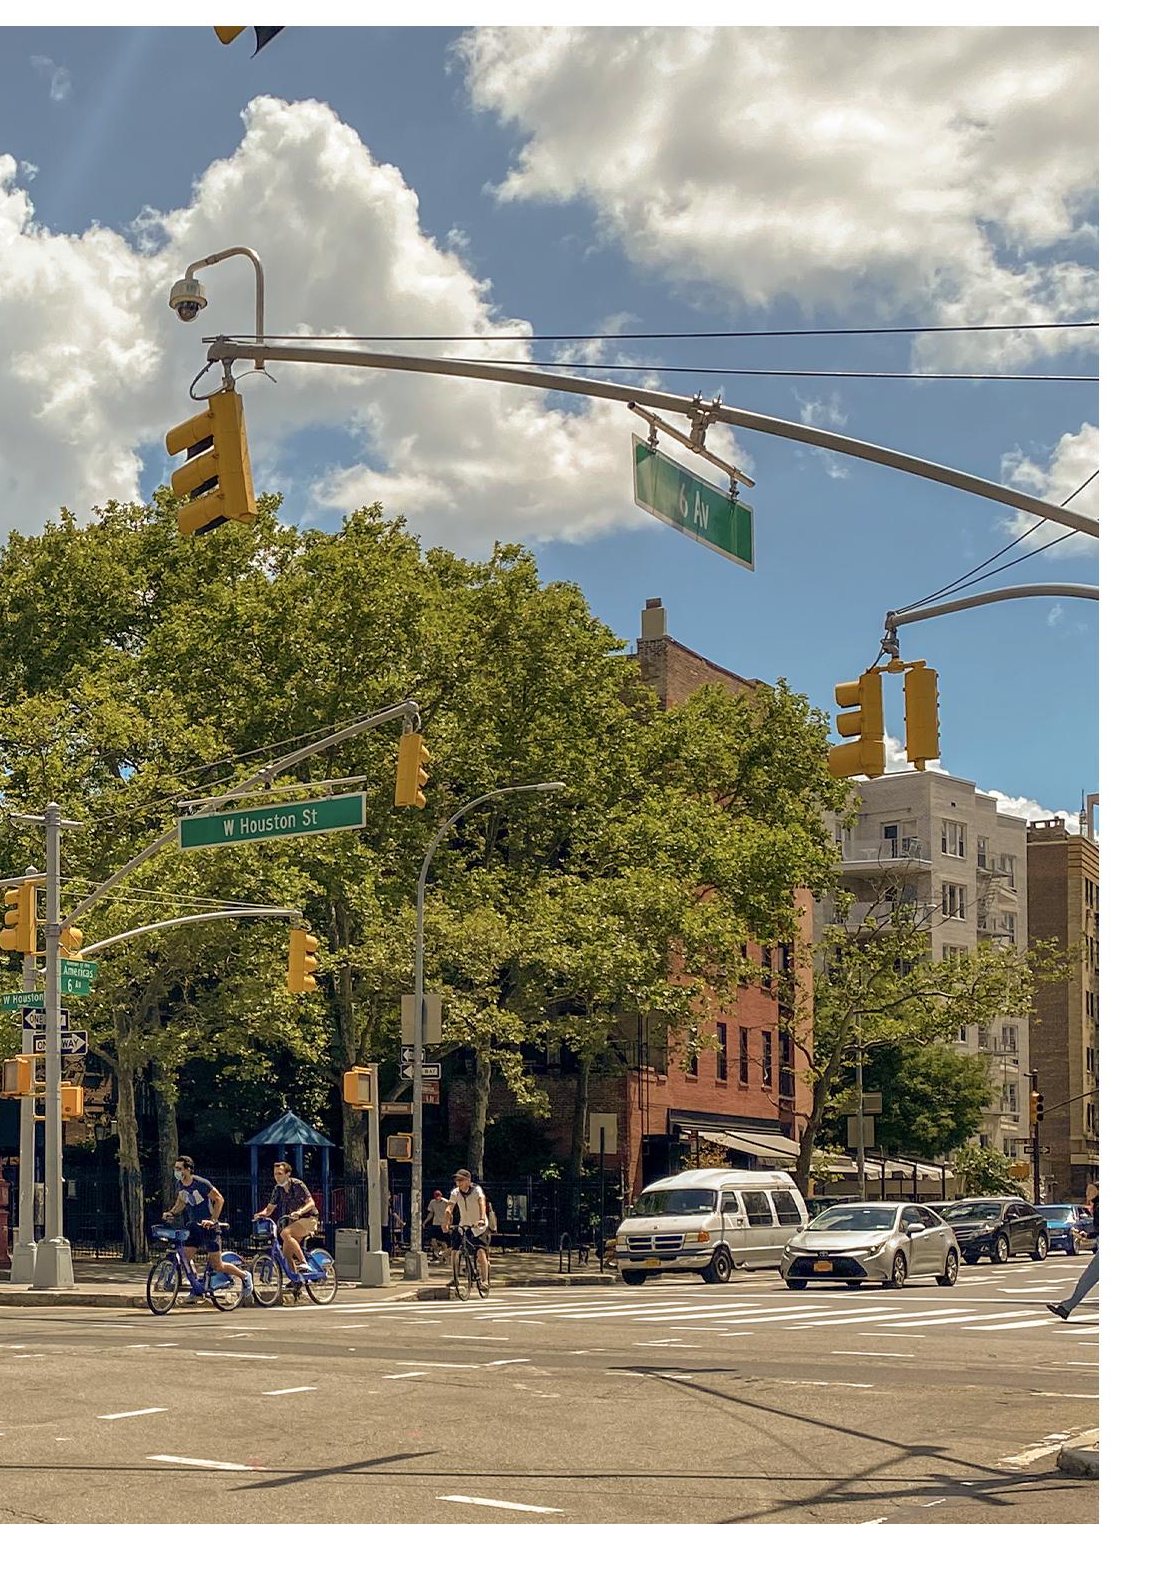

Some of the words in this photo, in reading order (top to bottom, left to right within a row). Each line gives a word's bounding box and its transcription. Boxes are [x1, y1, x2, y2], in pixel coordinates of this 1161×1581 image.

[679, 483, 688, 518] 6
[694, 490, 709, 530] Av
[223, 819, 234, 836] W
[240, 813, 296, 834] Houston
[302, 808, 318, 826] St
[63, 965, 94, 978] Americas
[67, 978, 73, 992] 6
[3, 996, 10, 1005] W
[12, 992, 44, 1004] Houston
[61, 1038, 79, 1048] WAY
